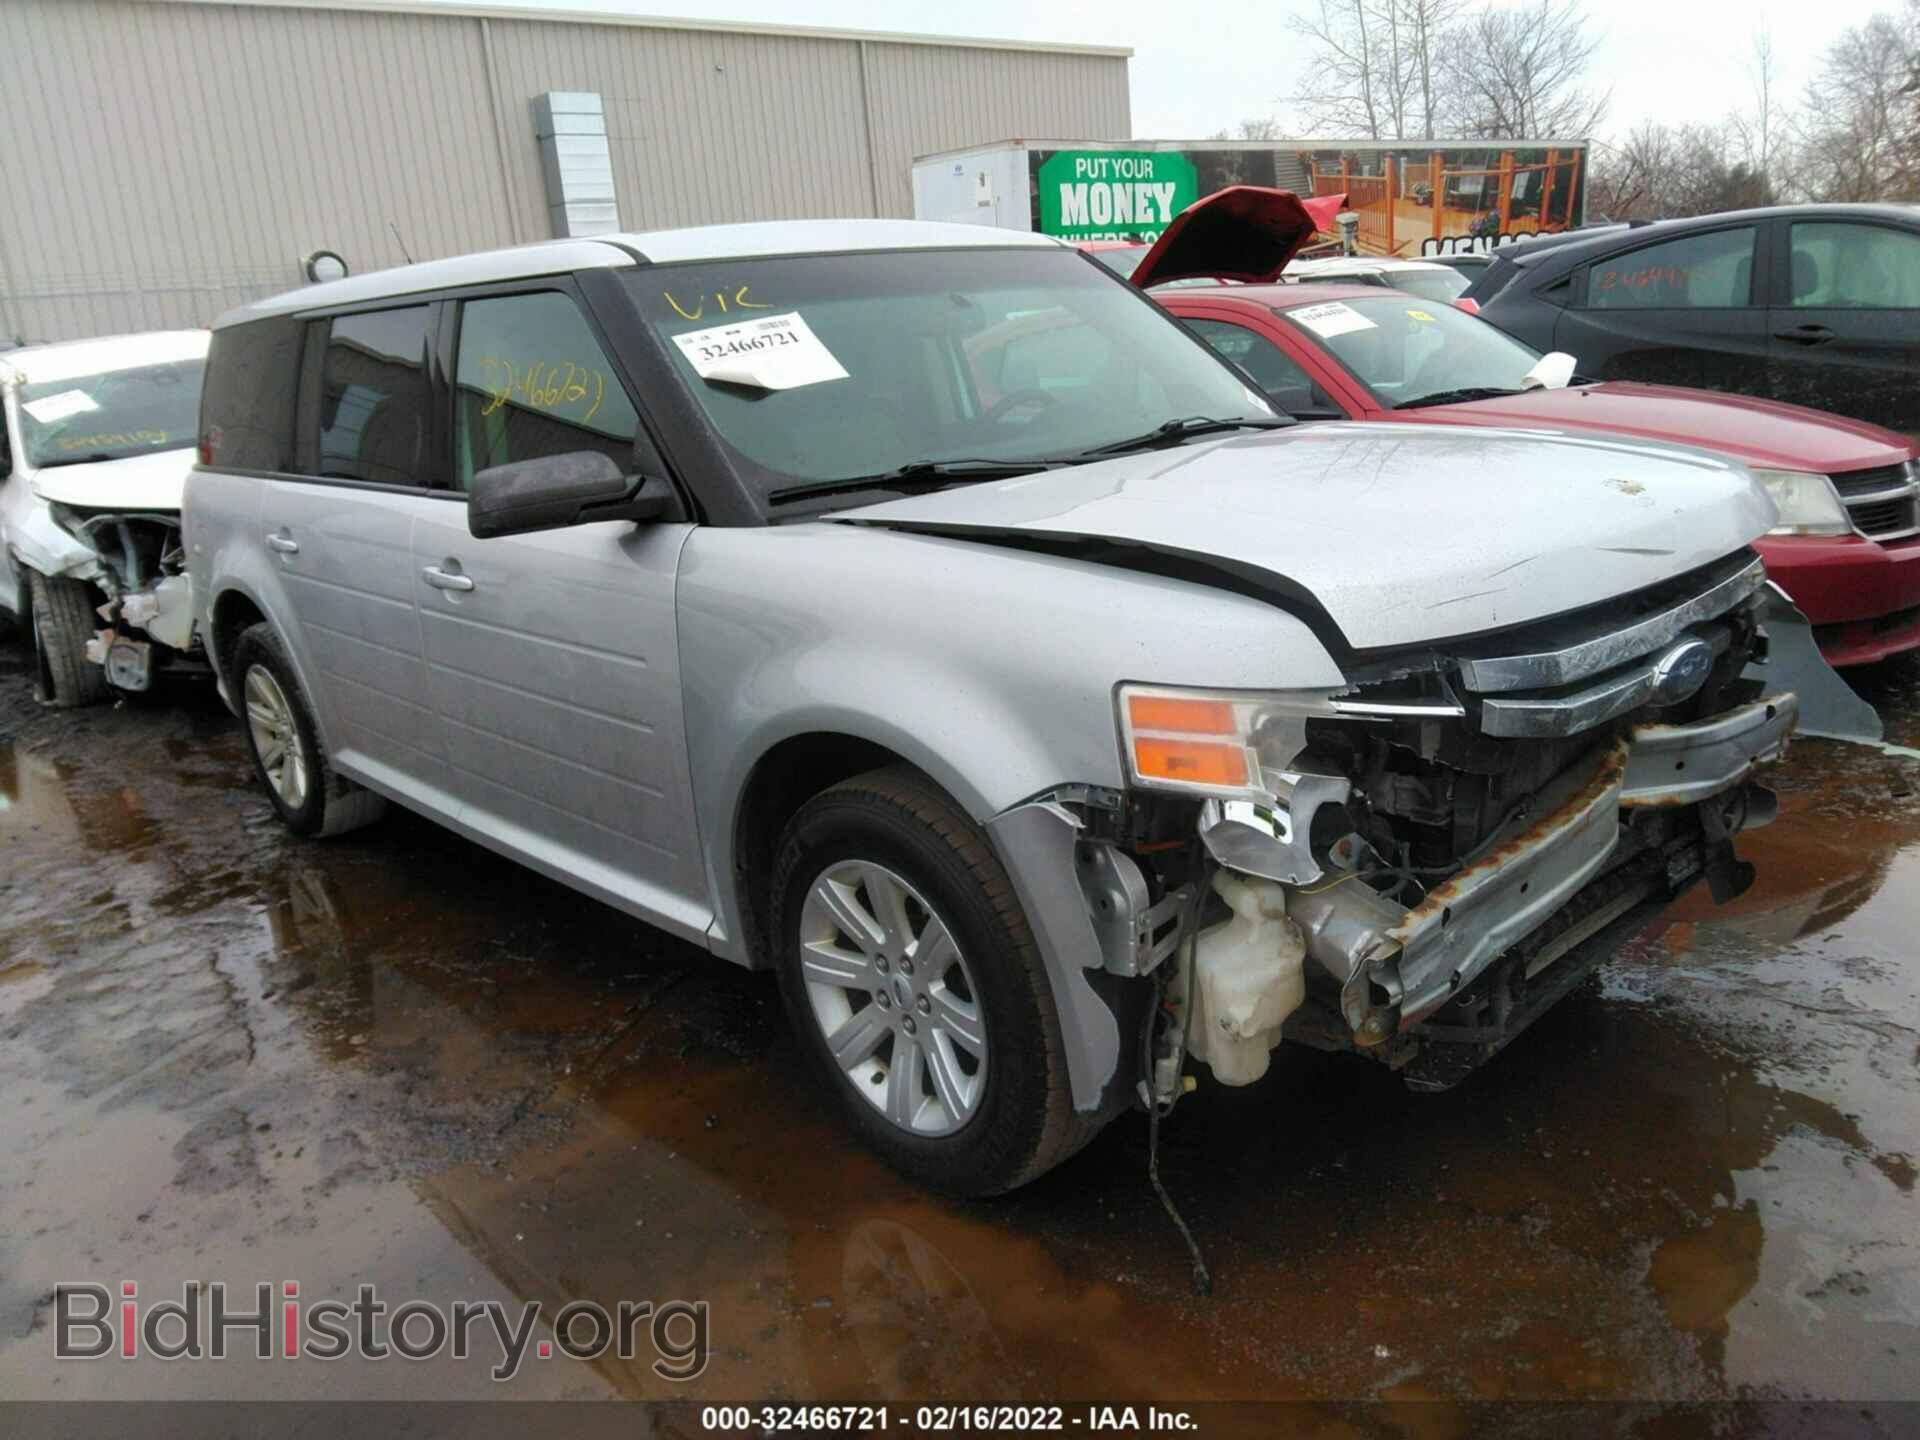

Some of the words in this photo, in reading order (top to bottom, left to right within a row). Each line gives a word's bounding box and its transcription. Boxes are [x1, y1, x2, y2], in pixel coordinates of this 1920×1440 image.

[1075, 157, 1109, 178] PUT
[1111, 157, 1154, 179] YOUR
[1060, 181, 1176, 226] MONEY
[698, 330, 800, 361] 32466721
